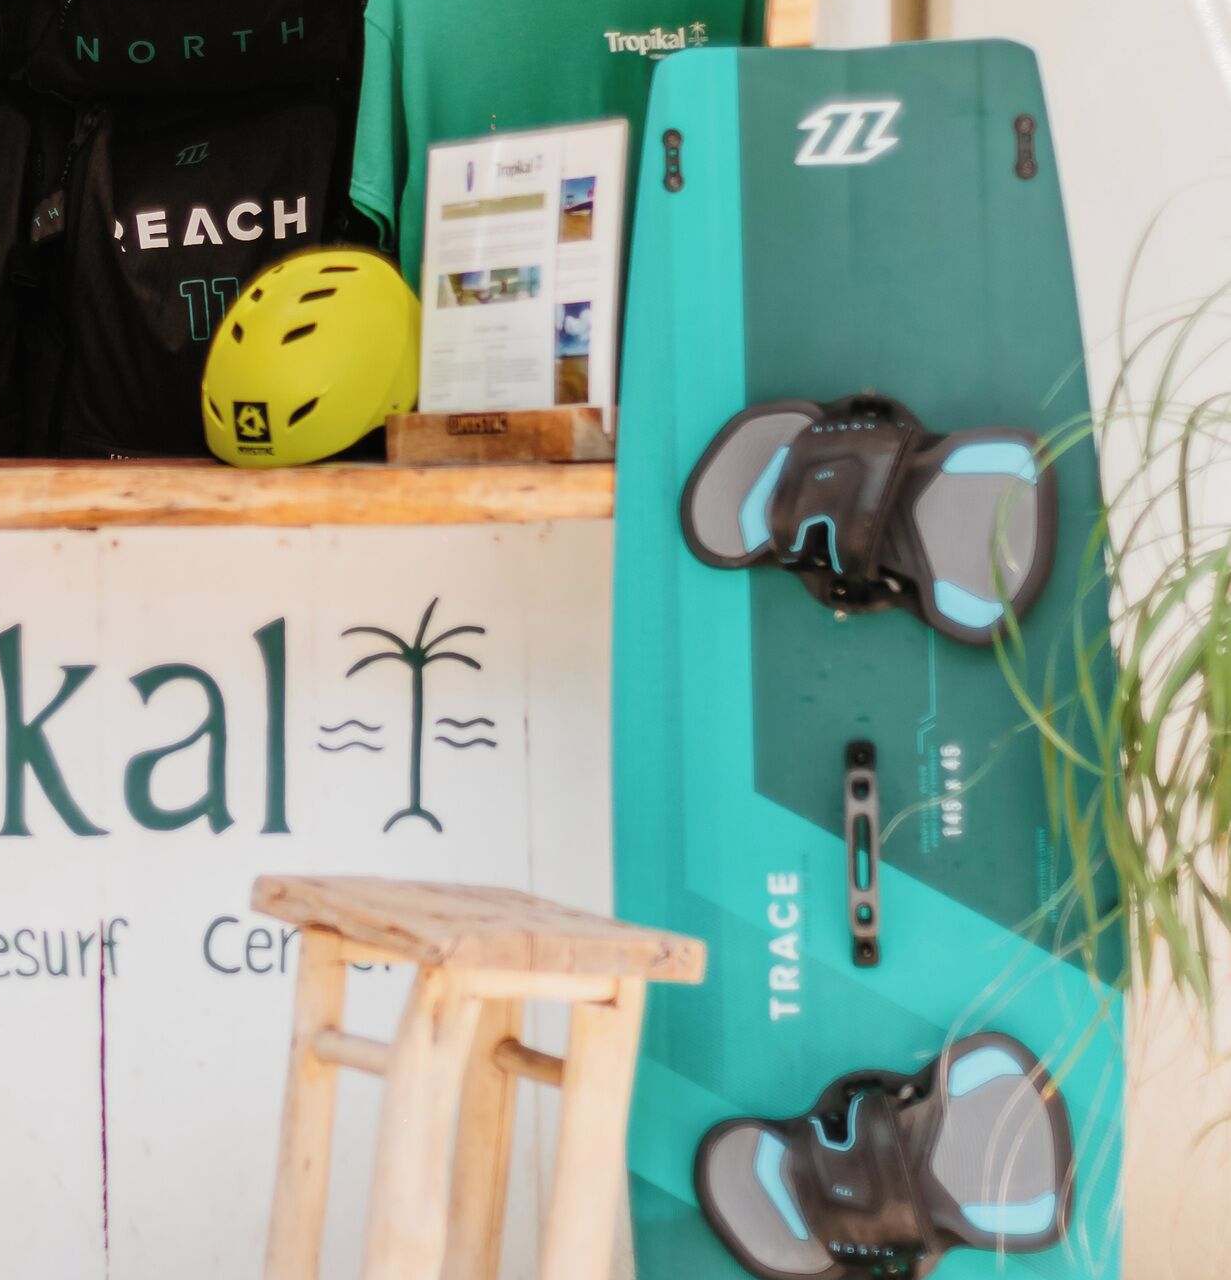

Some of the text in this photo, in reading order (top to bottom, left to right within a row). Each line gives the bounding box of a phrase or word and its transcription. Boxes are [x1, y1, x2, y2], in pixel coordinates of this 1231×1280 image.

[76, 17, 305, 64] NORTH
[603, 27, 686, 56] Tropikal
[766, 871, 801, 1023] TRACE
[831, 1241, 894, 1257] NORTH
